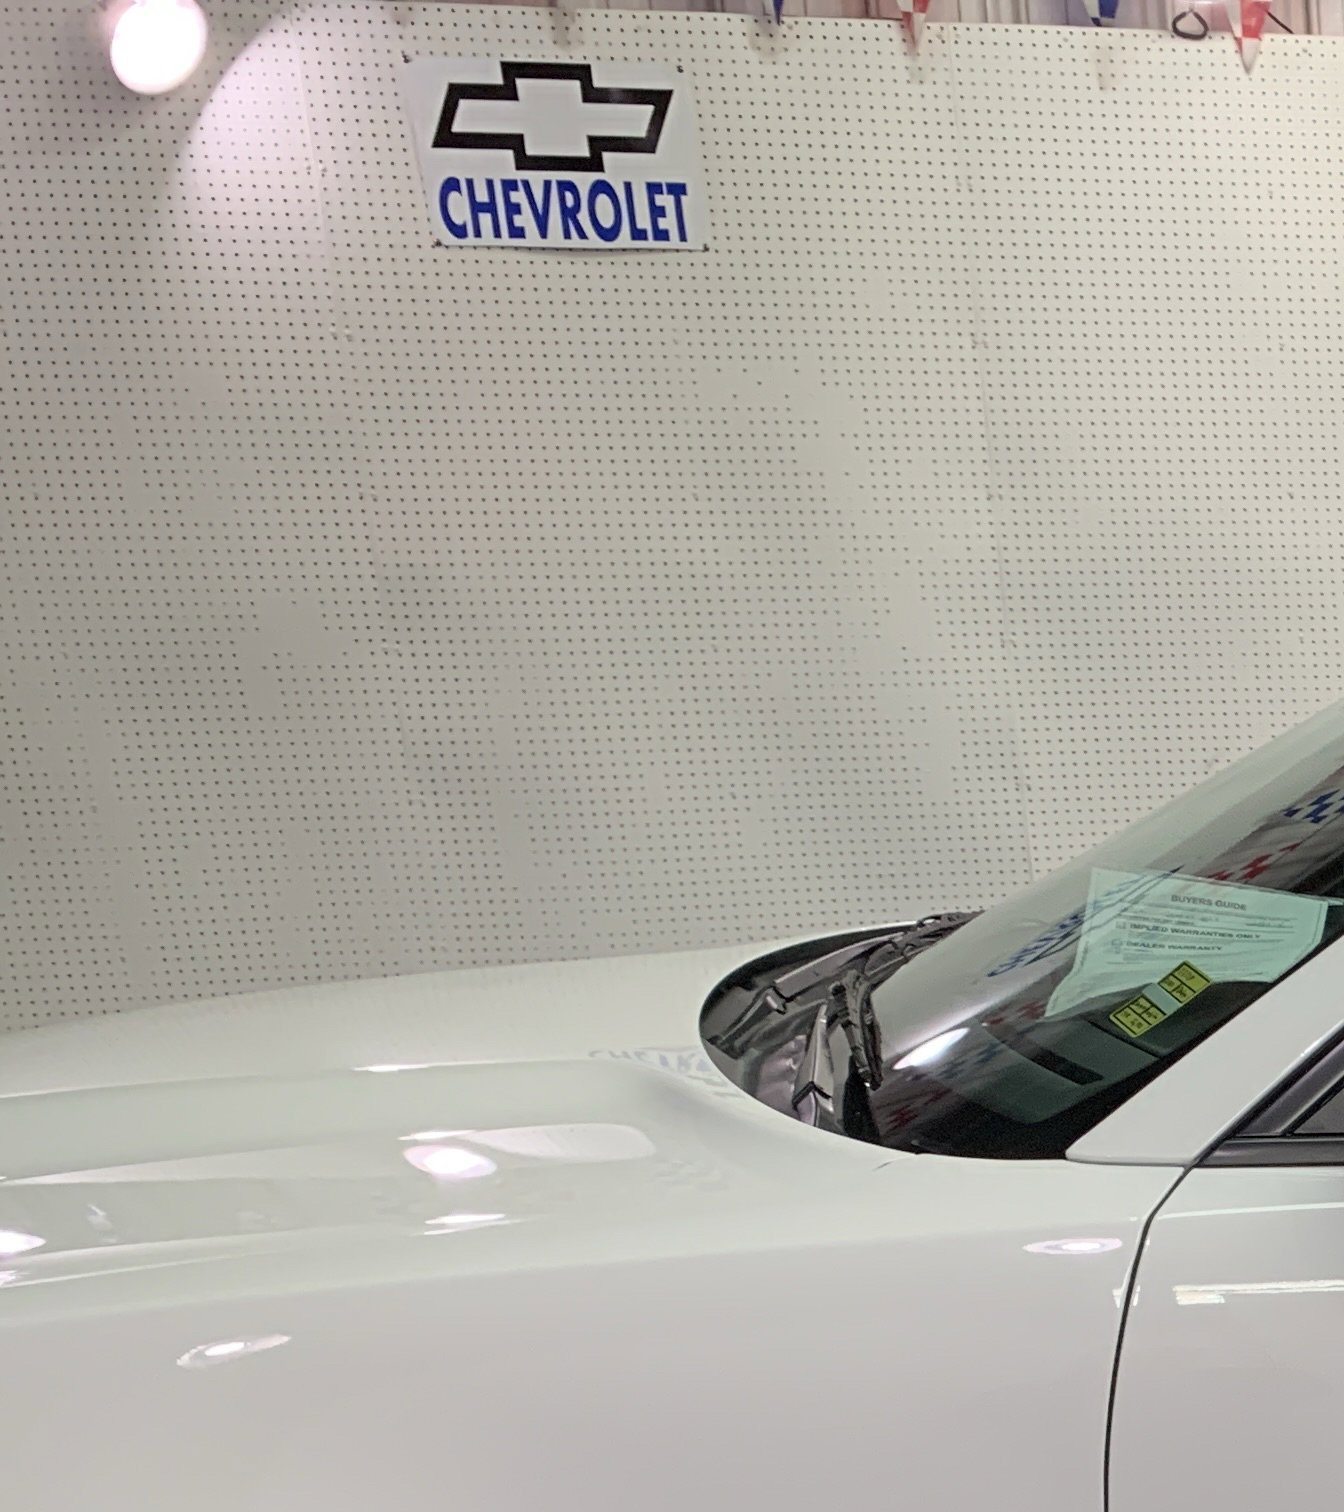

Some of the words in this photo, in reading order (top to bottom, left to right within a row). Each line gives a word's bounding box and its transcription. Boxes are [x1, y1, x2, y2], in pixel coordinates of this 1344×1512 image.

[438, 176, 689, 243] CHEVROLET
[1170, 894, 1214, 908] BUYERS
[1215, 899, 1247, 912] GUIDE
[1129, 922, 1169, 933] IMPLIED
[1170, 927, 1234, 939] WARRANTIES
[1167, 943, 1223, 951] WARRANTY
